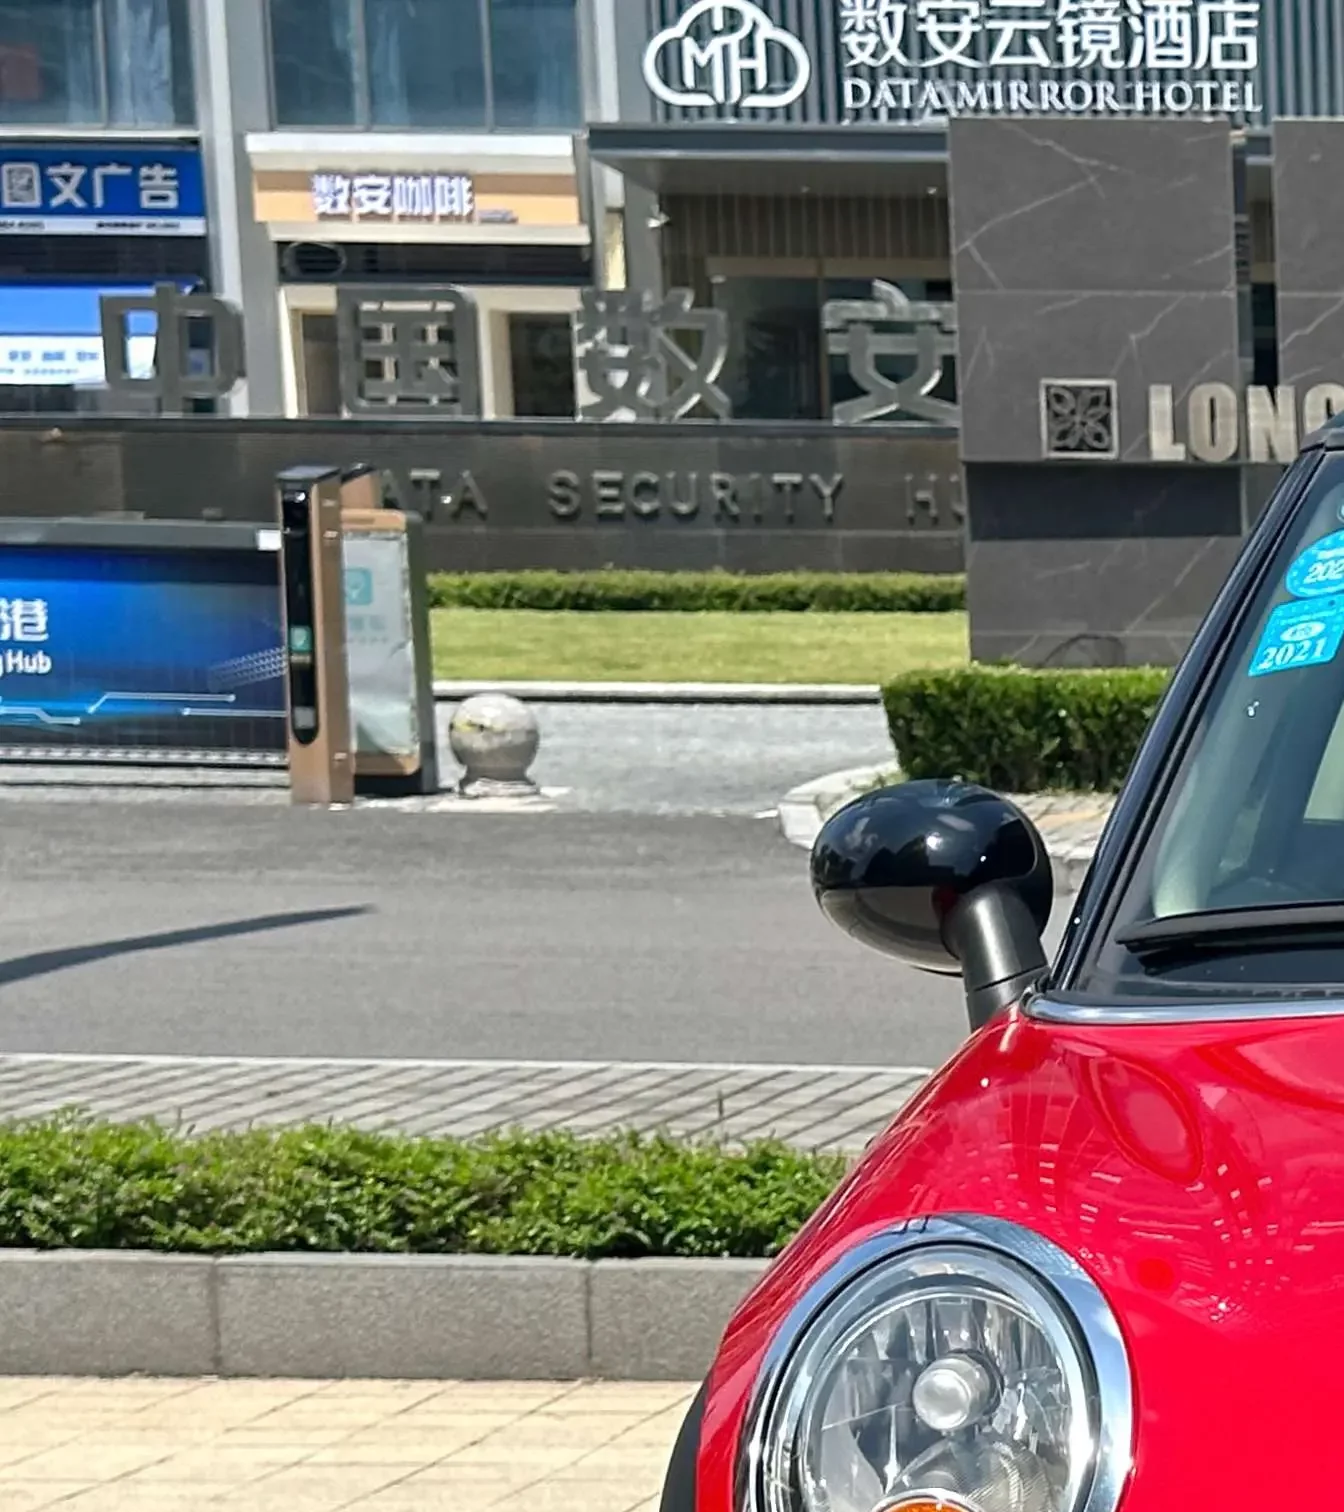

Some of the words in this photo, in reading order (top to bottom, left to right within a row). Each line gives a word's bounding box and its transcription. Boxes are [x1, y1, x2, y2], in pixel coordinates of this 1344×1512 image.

[840, 0, 1260, 69] 数安云镜酒店
[843, 77, 946, 110] DATA
[956, 79, 1119, 111] MIRROR
[1133, 80, 1262, 112] HOTEL
[1, 161, 179, 209] 图文广告
[312, 174, 474, 216] 数安咖啡
[378, 468, 488, 516] ATA
[549, 469, 842, 516] SECURITY
[7, 649, 52, 674] Hub
[1257, 638, 1326, 669] 2021
